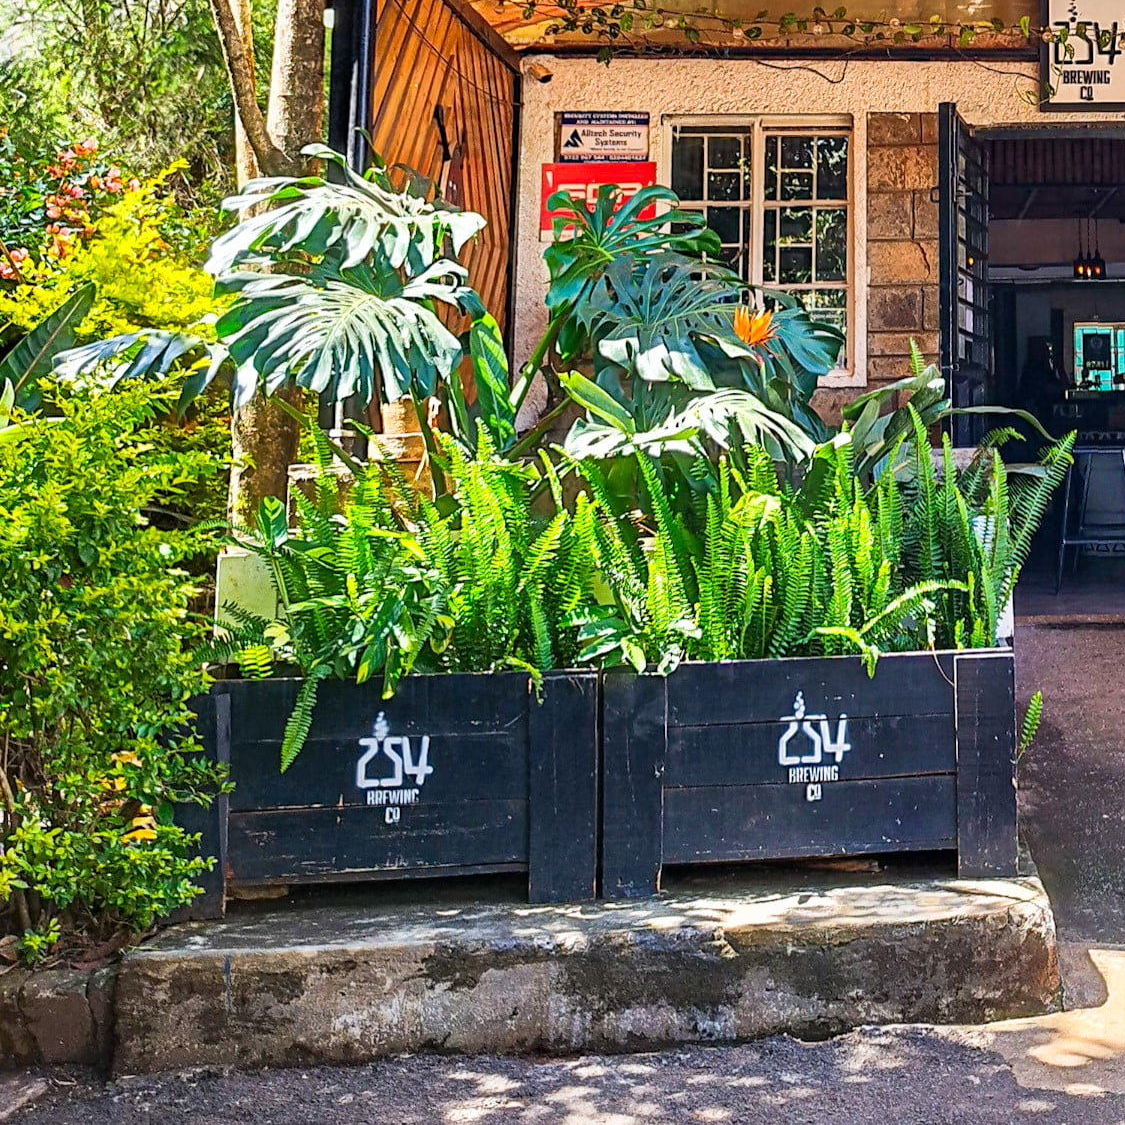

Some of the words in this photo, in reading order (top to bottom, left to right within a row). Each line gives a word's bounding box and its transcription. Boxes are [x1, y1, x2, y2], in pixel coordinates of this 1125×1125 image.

[1062, 70, 1111, 85] BREWING
[595, 138, 628, 147] Systems
[609, 129, 642, 139] Security
[779, 714, 851, 765] 254
[357, 735, 434, 788] 254
[789, 765, 840, 783] BREWING
[366, 788, 420, 806] BREWING
